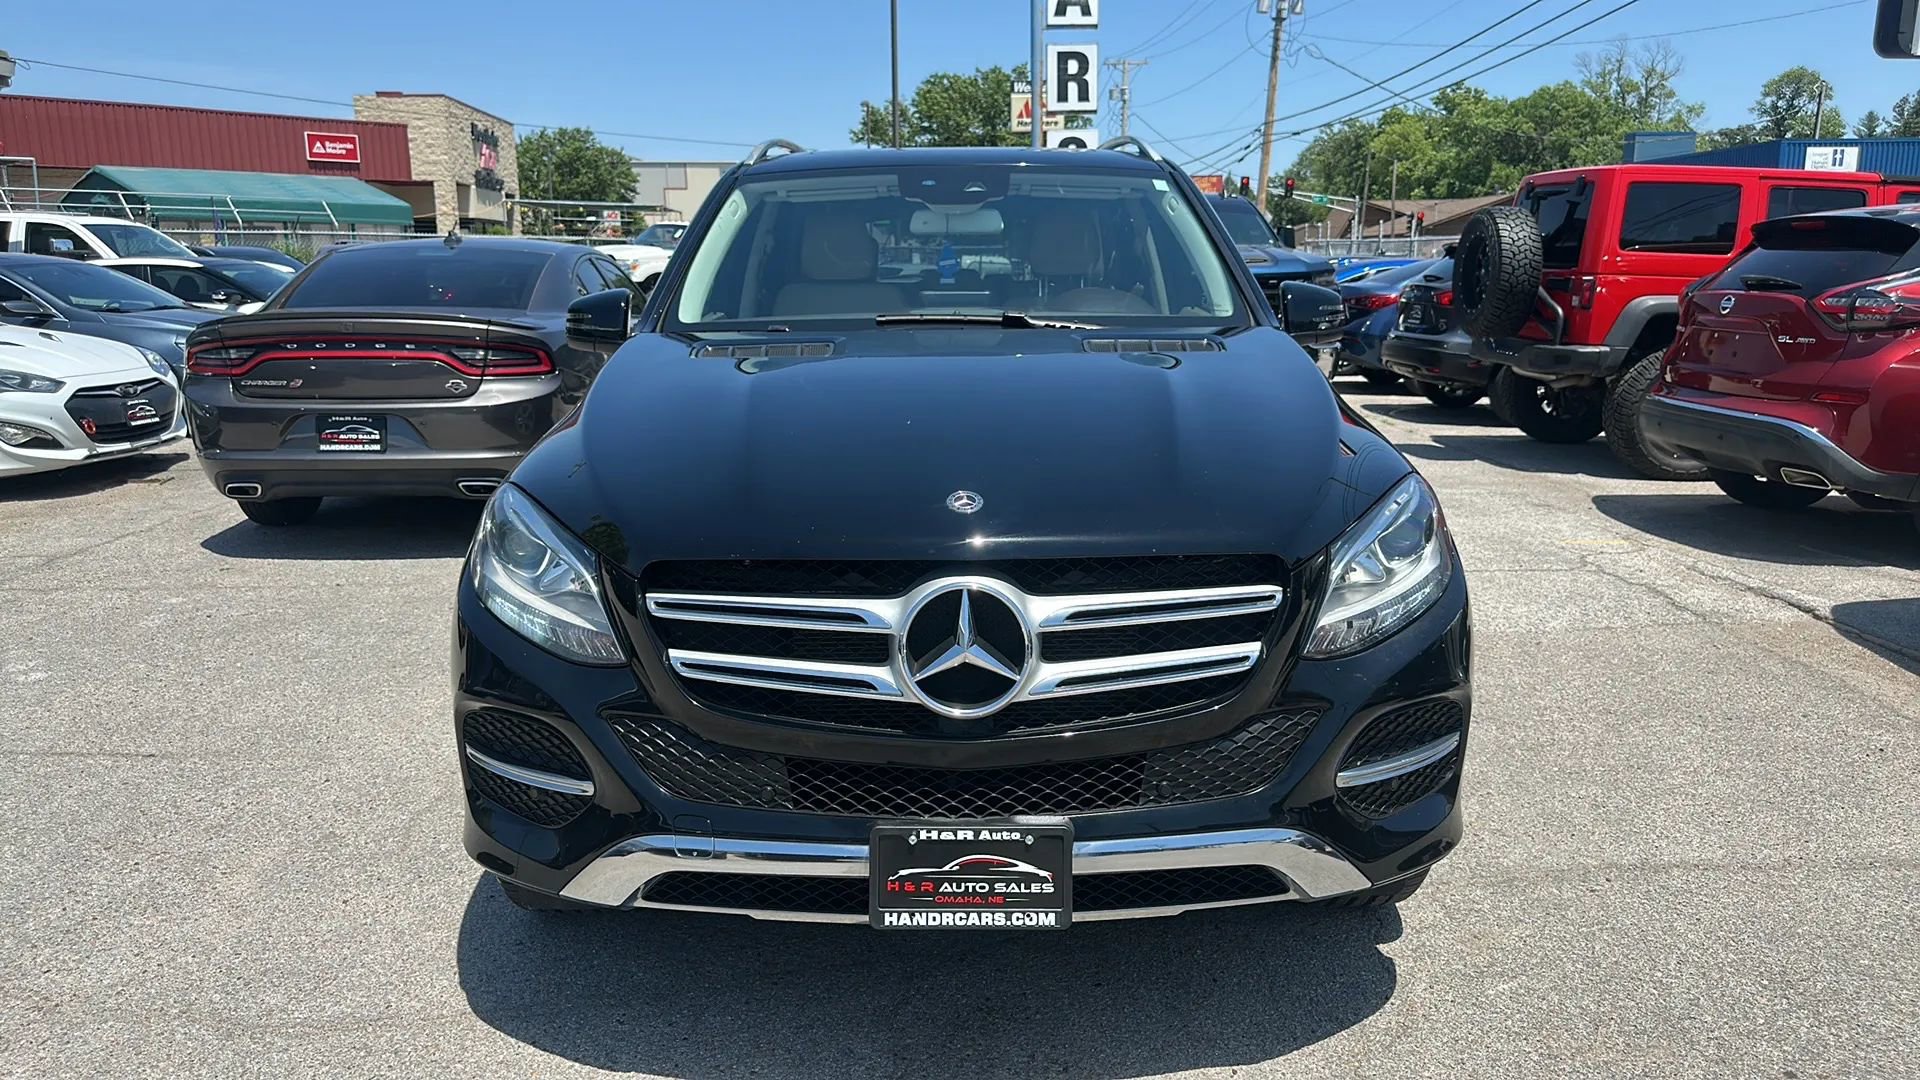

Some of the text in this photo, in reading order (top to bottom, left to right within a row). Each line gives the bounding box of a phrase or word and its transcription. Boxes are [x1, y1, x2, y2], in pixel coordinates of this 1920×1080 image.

[325, 141, 354, 149] Benjamin
[1778, 335, 1793, 343] SL
[919, 830, 1021, 841] H&R Auto
[887, 881, 1055, 894] H & R AUTO SALES
[934, 895, 1005, 904] OMAHA, NE
[884, 912, 1056, 926] HANDRCARS.COM
